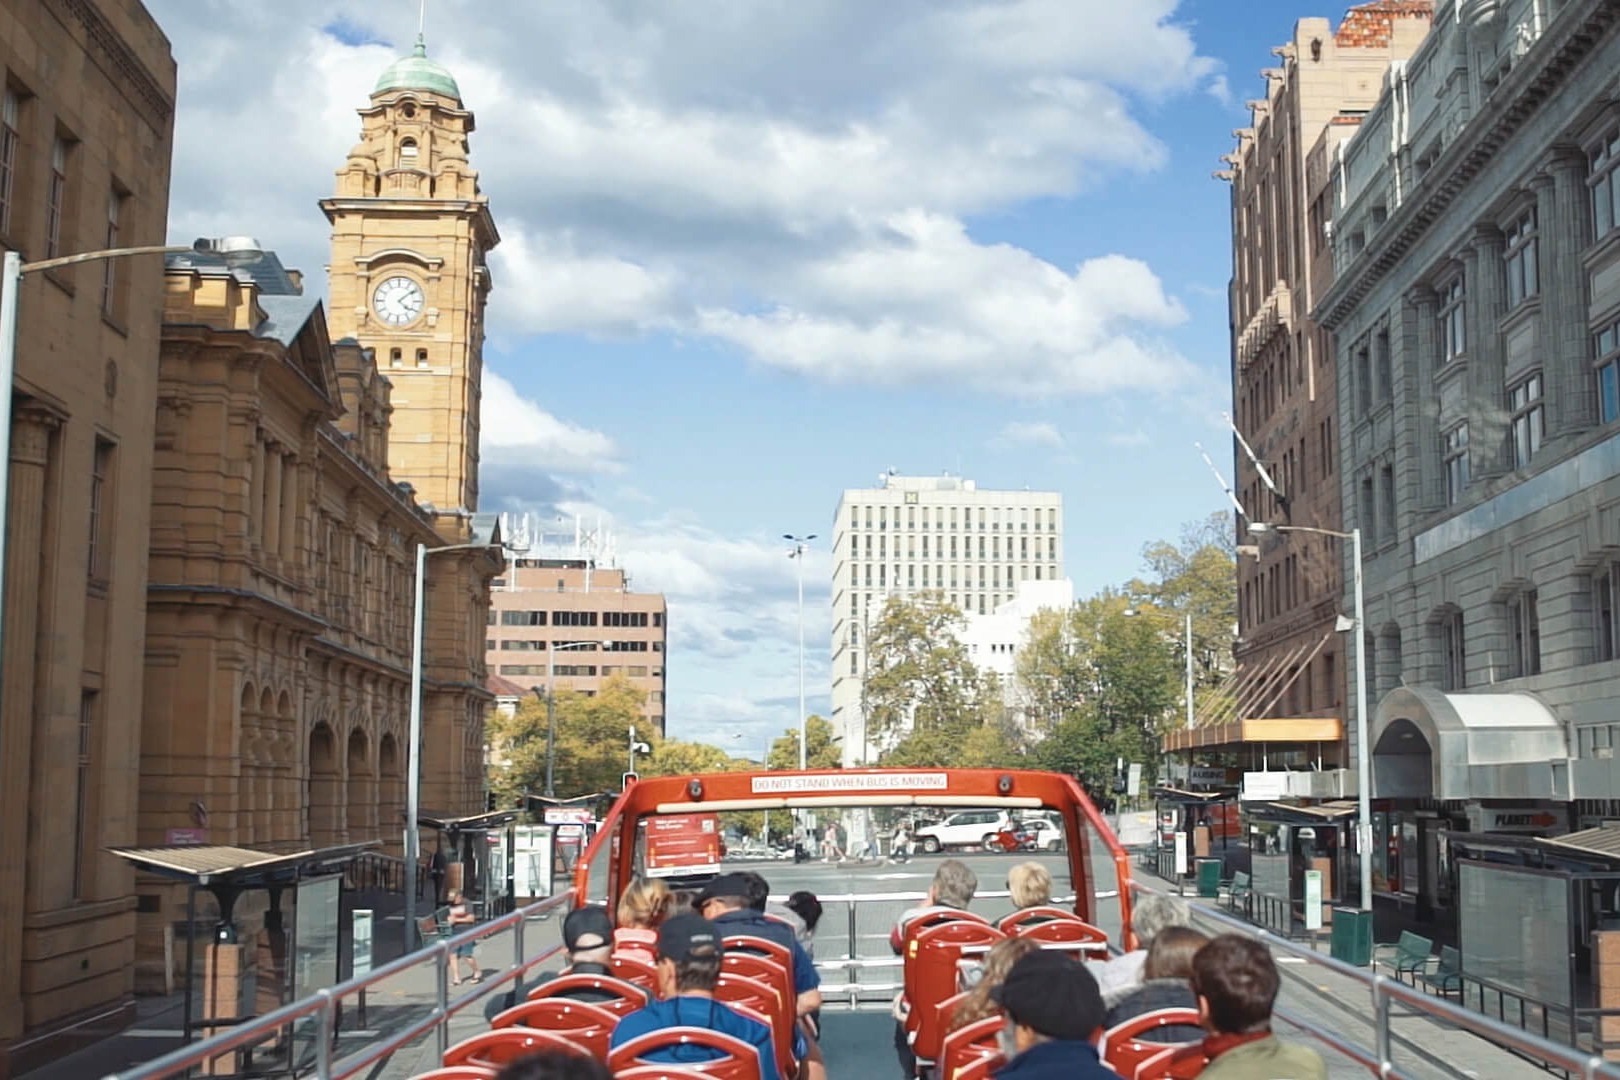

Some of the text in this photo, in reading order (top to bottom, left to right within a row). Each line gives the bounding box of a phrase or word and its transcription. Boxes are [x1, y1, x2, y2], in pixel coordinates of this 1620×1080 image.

[755, 775, 944, 790] DO NOT STAND WHEN BUS IS MOVING
